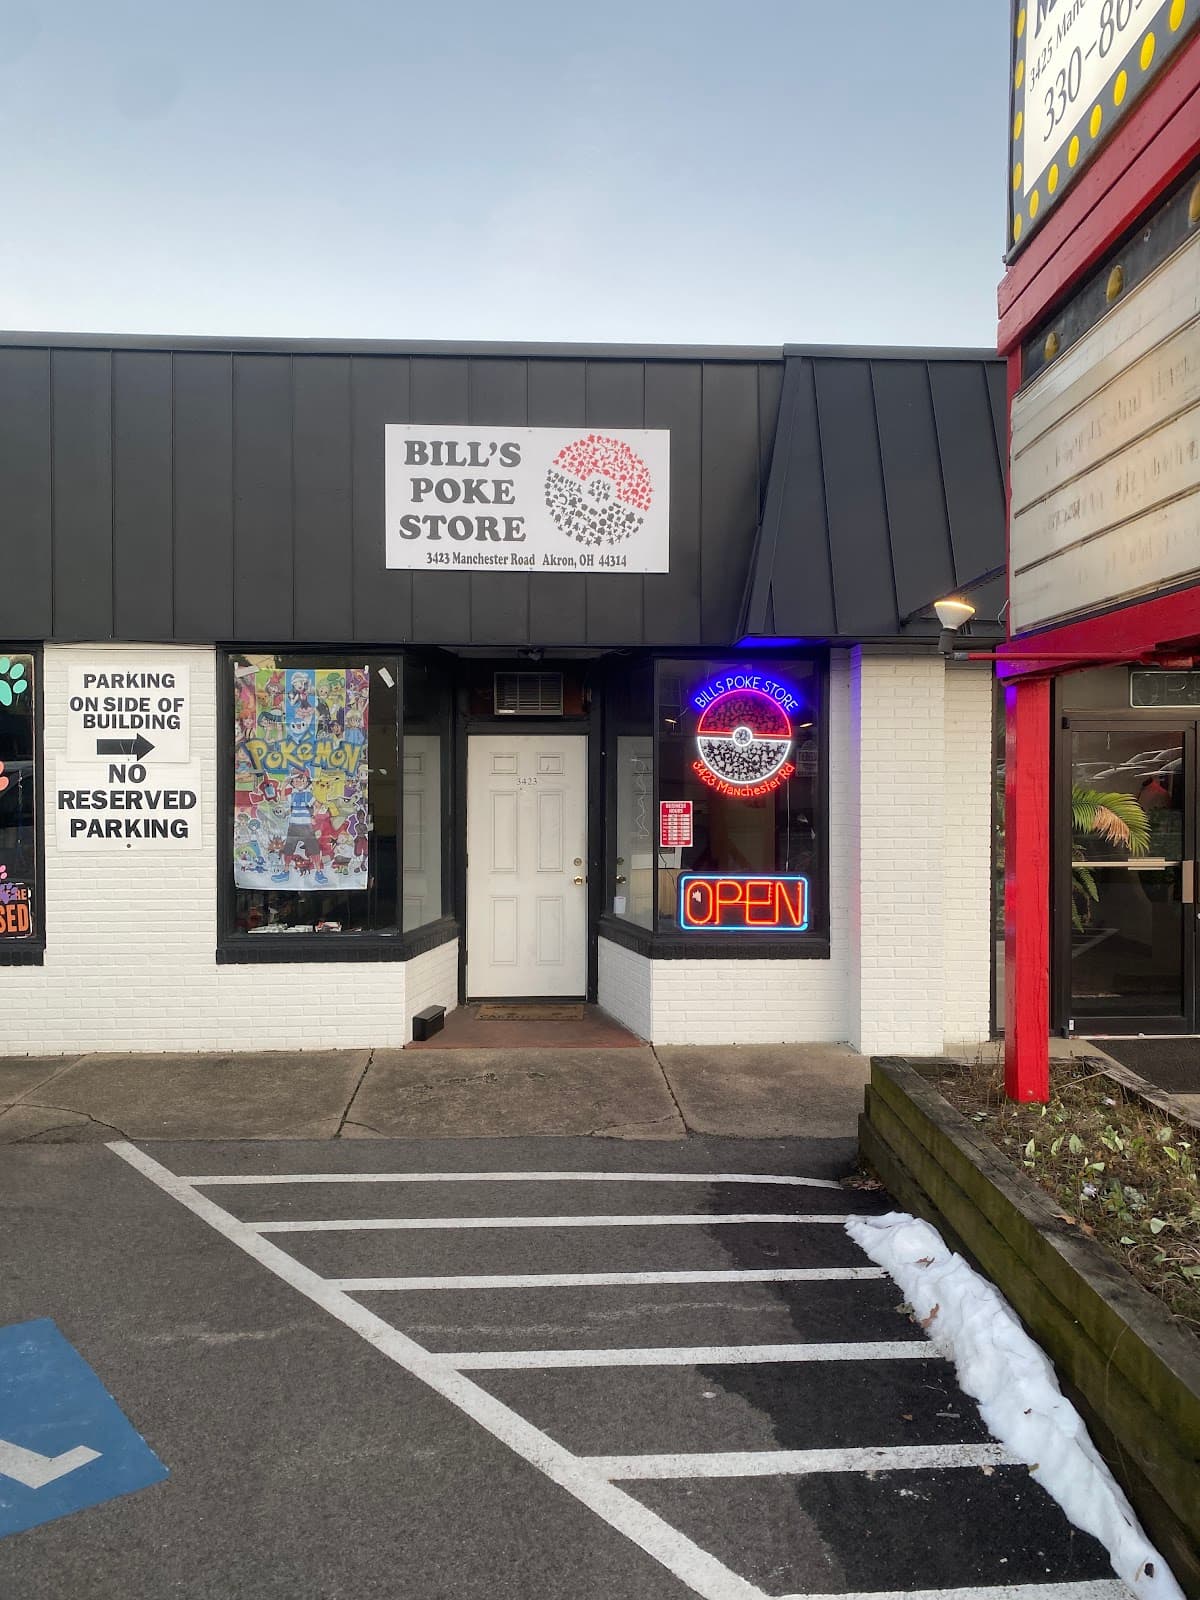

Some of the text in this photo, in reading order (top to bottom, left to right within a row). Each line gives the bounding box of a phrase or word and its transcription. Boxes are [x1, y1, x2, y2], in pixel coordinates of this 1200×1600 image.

[1030, 36, 1053, 92] 3425
[1044, 0, 1143, 142] 330-86
[404, 440, 521, 467] BILL'S
[410, 477, 516, 505] POKE
[399, 515, 526, 542] STORE
[426, 551, 627, 568] 3423 Manchester Road Akron, OH 44314
[83, 673, 175, 689] PARKING
[69, 696, 185, 713] ON SIDE OF
[694, 675, 799, 712] BILLS POKE STORE
[83, 713, 181, 730] BUILDING
[108, 763, 147, 784] NO
[516, 776, 538, 786] 3423
[692, 760, 796, 797] 3423 Manchester Rd
[57, 790, 197, 810] RESERVED
[70, 818, 189, 839] PARKING
[686, 881, 804, 926] OPEN
